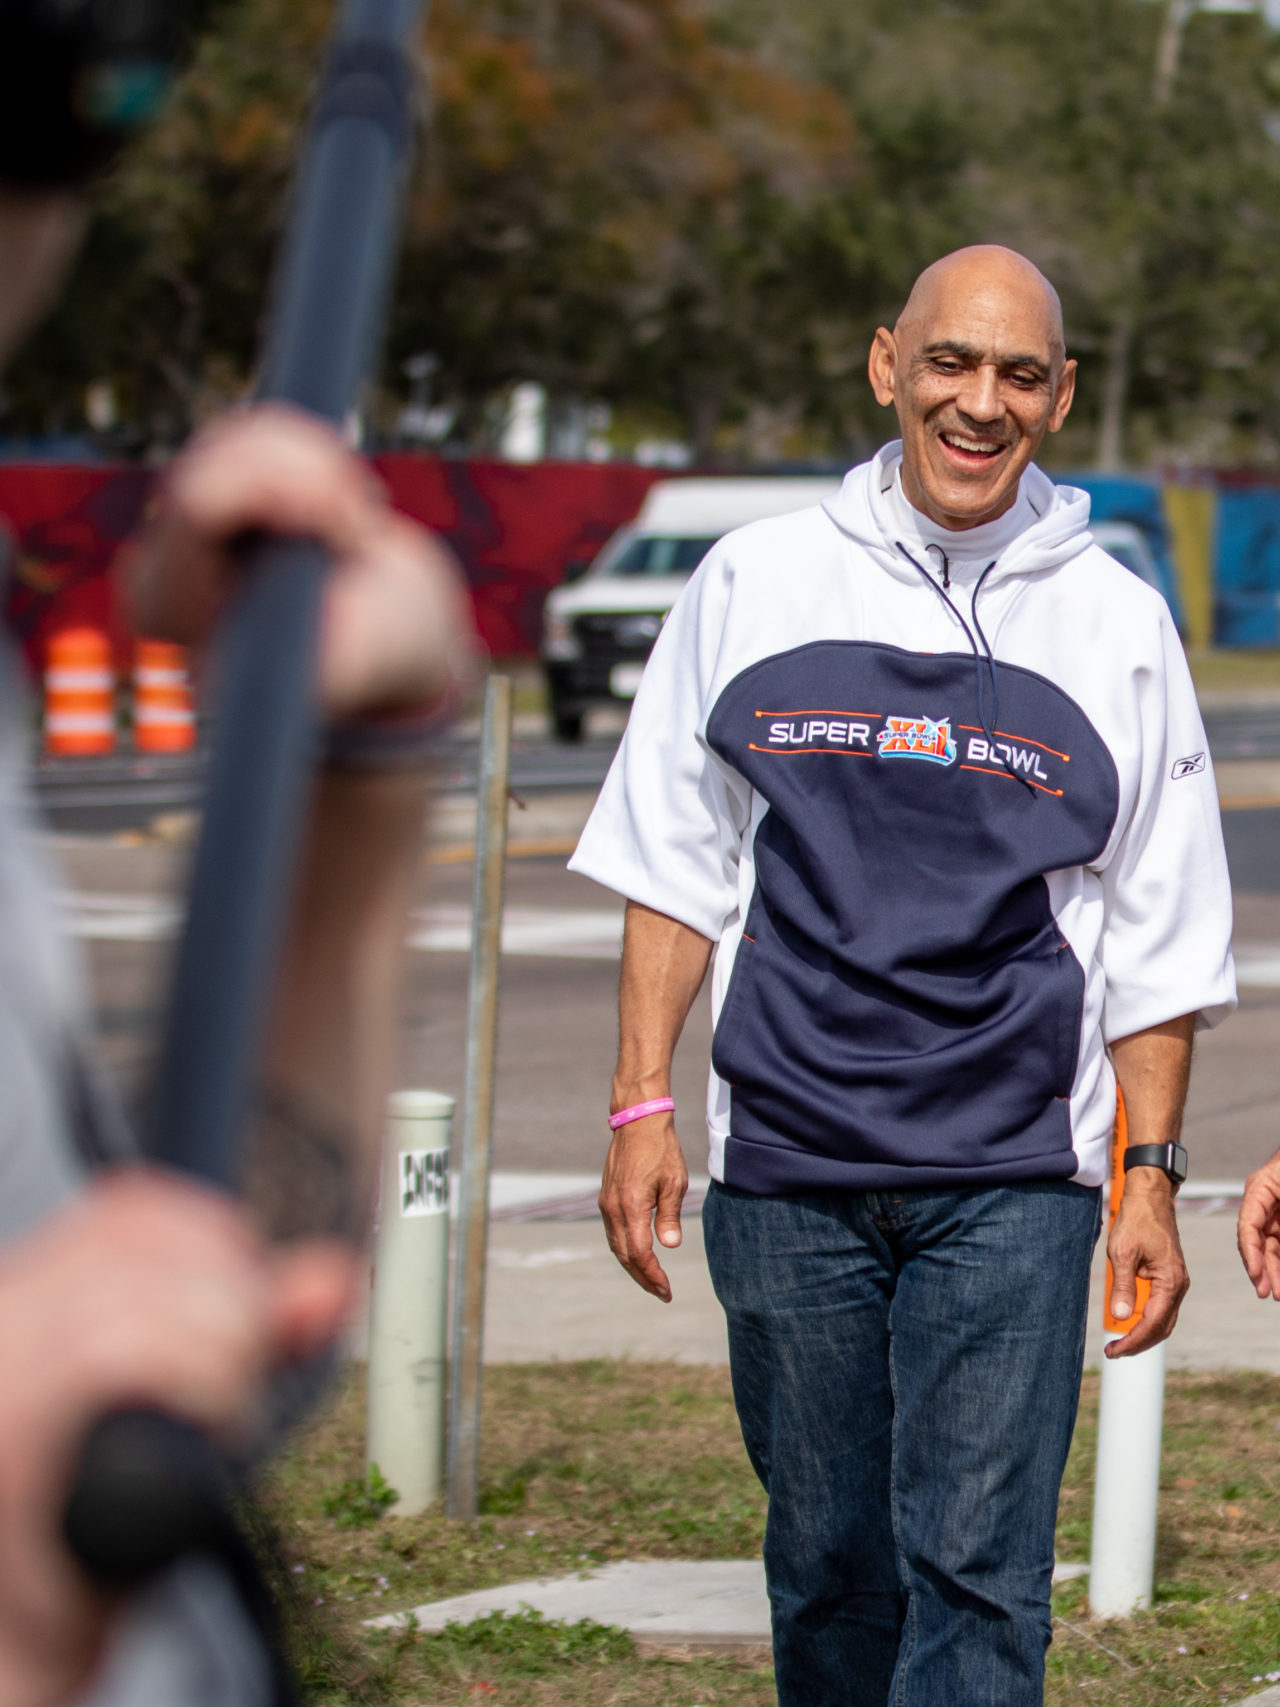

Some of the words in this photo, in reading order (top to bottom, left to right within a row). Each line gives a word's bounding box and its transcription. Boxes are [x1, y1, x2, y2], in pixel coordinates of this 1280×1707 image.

[768, 721, 870, 746] SUPER
[882, 719, 948, 758] XLI
[967, 737, 1048, 780] BOWL
